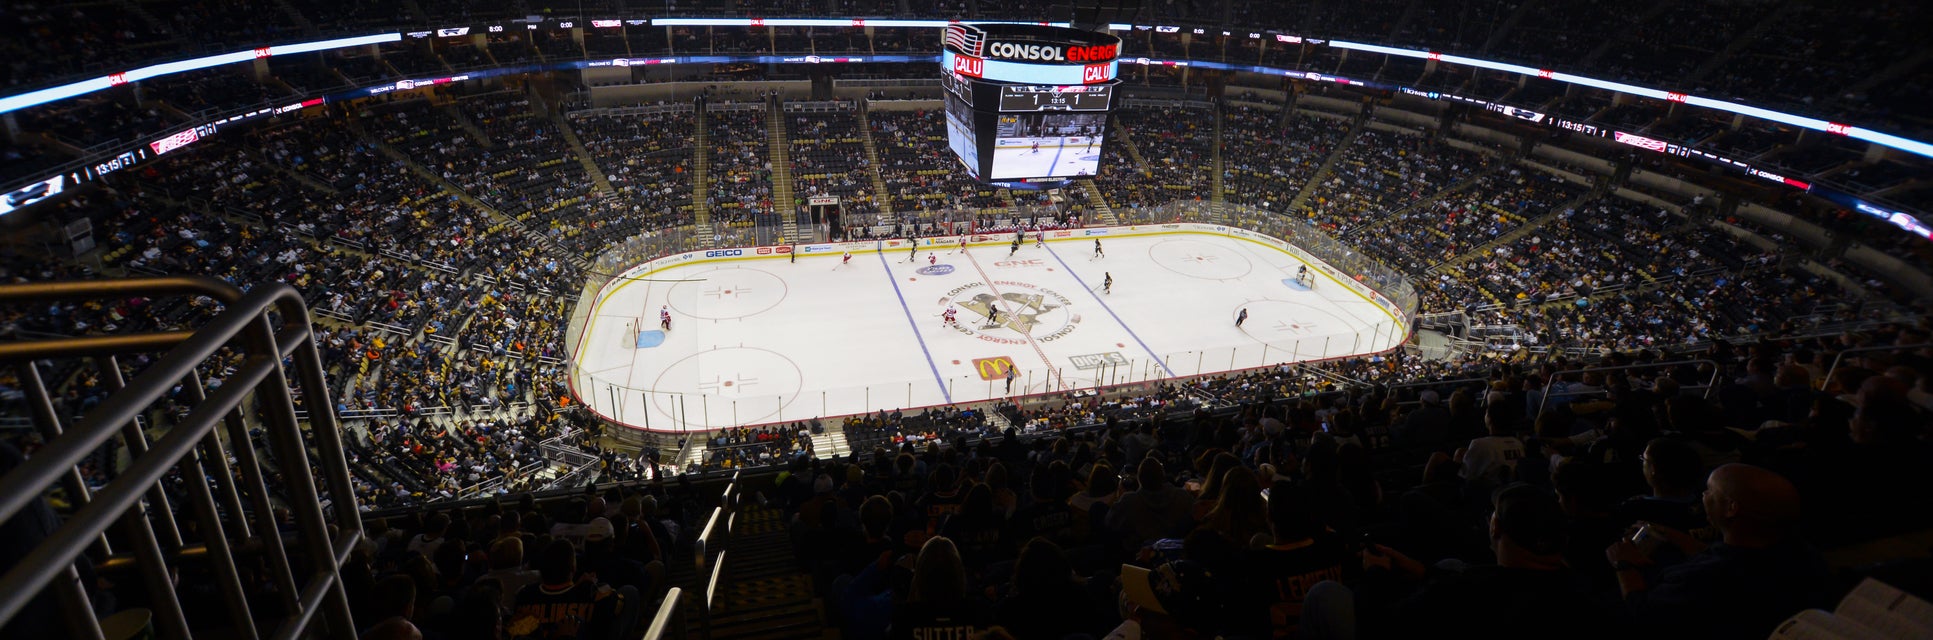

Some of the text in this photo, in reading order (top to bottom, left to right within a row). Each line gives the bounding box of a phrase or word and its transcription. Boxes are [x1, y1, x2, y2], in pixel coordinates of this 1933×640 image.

[990, 42, 1064, 60] CONSOL
[955, 57, 982, 75] CAL U
[1085, 65, 1109, 81] CAL U
[1033, 94, 1038, 105] 1
[1074, 94, 1079, 104] 1
[1668, 93, 1678, 101] CAL
[282, 102, 302, 112] CONSOL
[1562, 120, 1583, 132] 13:15
[71, 172, 80, 184] 1
[95, 159, 118, 176] 13:15
[138, 148, 146, 159] 1
[1758, 170, 1784, 183] CONSOL
[706, 250, 742, 258] GEICO
[948, 280, 1072, 306] CONSOL ENERGY CENTER
[976, 335, 1027, 345] ENERGY
[1037, 324, 1076, 343] CONSOL
[1075, 352, 1124, 368] DICK'S
